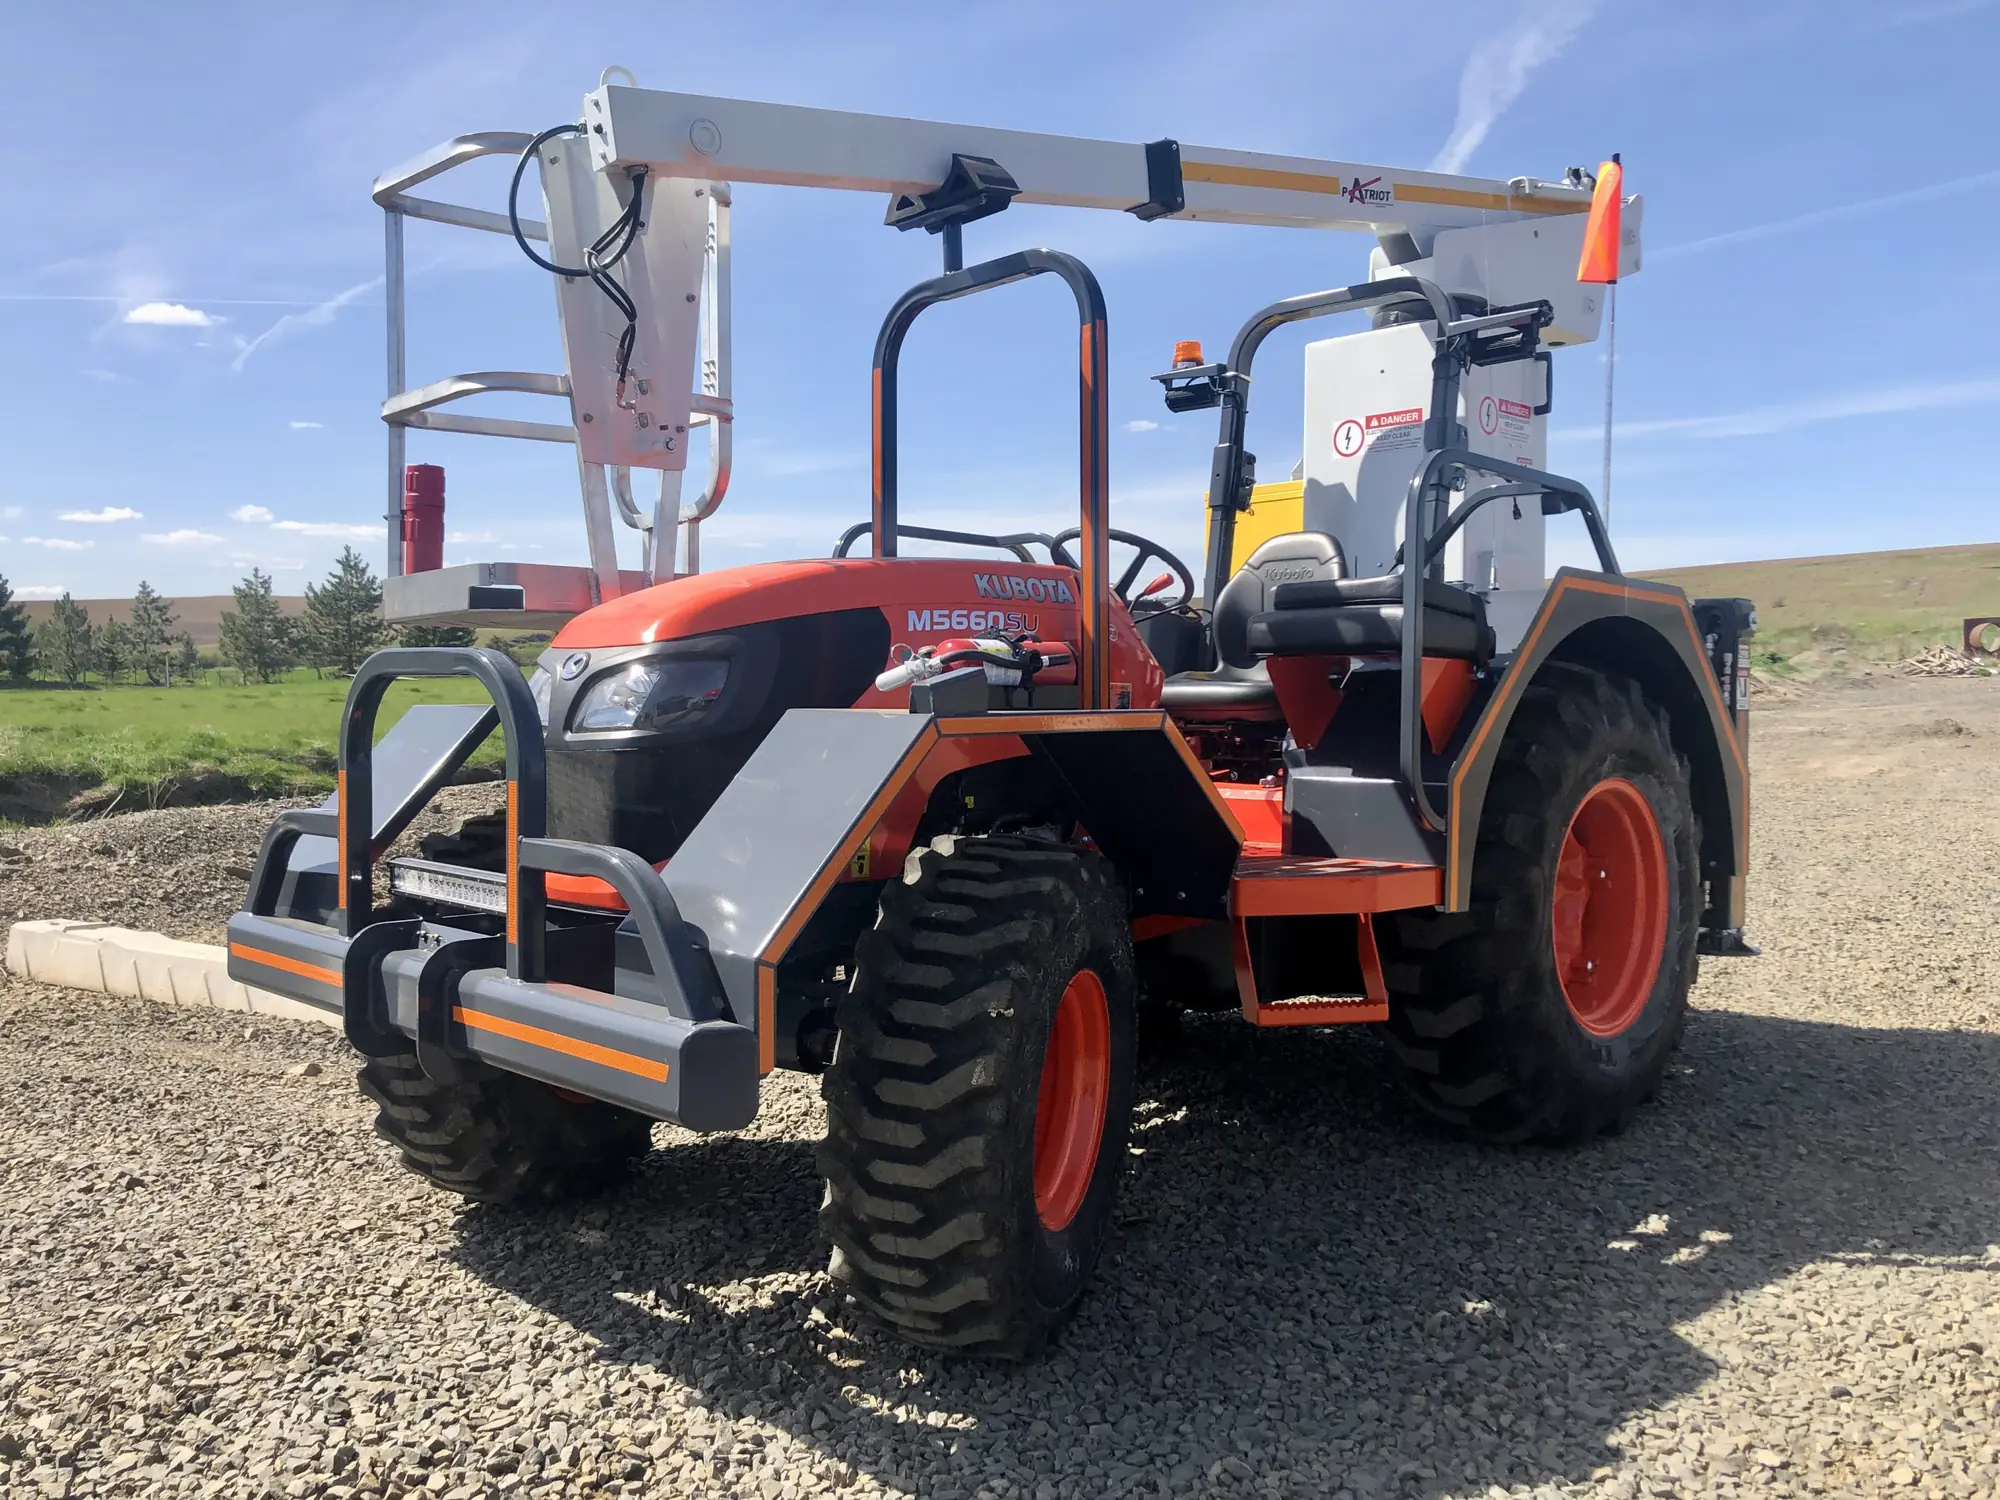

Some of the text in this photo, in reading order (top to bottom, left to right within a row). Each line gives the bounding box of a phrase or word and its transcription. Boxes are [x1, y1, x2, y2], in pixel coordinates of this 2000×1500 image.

[1342, 177, 1391, 204] PATRIOT
[1380, 412, 1419, 426] DANGER
[1377, 431, 1411, 441] KEEP CLEAR
[1264, 565, 1314, 581] Kubota
[973, 573, 1077, 604] KUBOTA
[907, 610, 1039, 632] M5660SU
